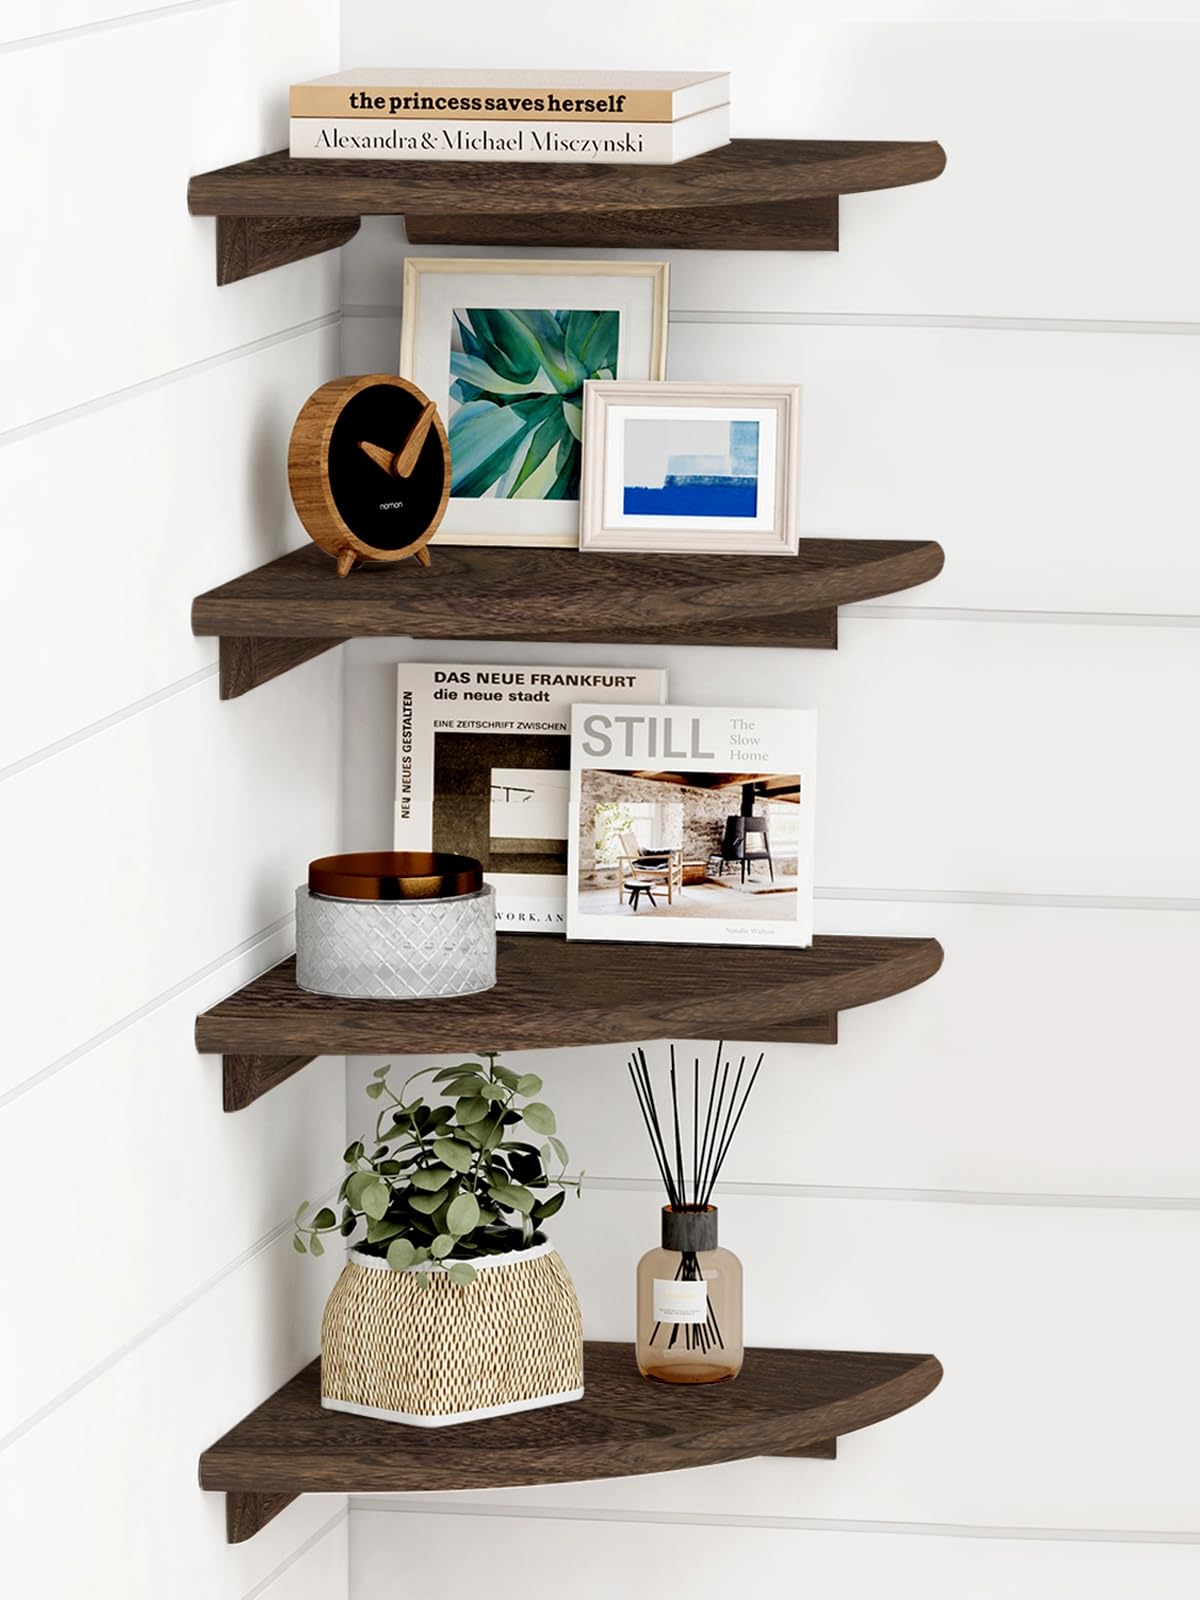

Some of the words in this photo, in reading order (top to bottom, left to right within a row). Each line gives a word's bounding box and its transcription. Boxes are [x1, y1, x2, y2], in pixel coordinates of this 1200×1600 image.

[350, 92, 386, 109] the
[389, 92, 482, 114] princess
[485, 97, 545, 111] saves
[548, 94, 627, 113] herself
[315, 128, 417, 149] Alexandra
[421, 132, 438, 150] &
[441, 130, 522, 151] Michael
[530, 131, 643, 159] Misczynski
[379, 501, 403, 510] nomon
[434, 671, 471, 684] DAS
[476, 673, 525, 685] NEUE
[530, 673, 636, 688] FRANKFURT
[433, 688, 458, 701] die
[463, 690, 503, 701] neue
[508, 690, 550, 702] stadt
[402, 691, 413, 753] GESTALTEN
[433, 720, 454, 729] EINE
[456, 720, 515, 730] ZEITSCHRIFT
[516, 721, 568, 731] ZWISCHEN
[730, 719, 755, 731] The
[581, 714, 716, 760] STILL
[730, 734, 760, 746] Slow
[730, 749, 769, 762] Home
[402, 756, 412, 793] NEUES
